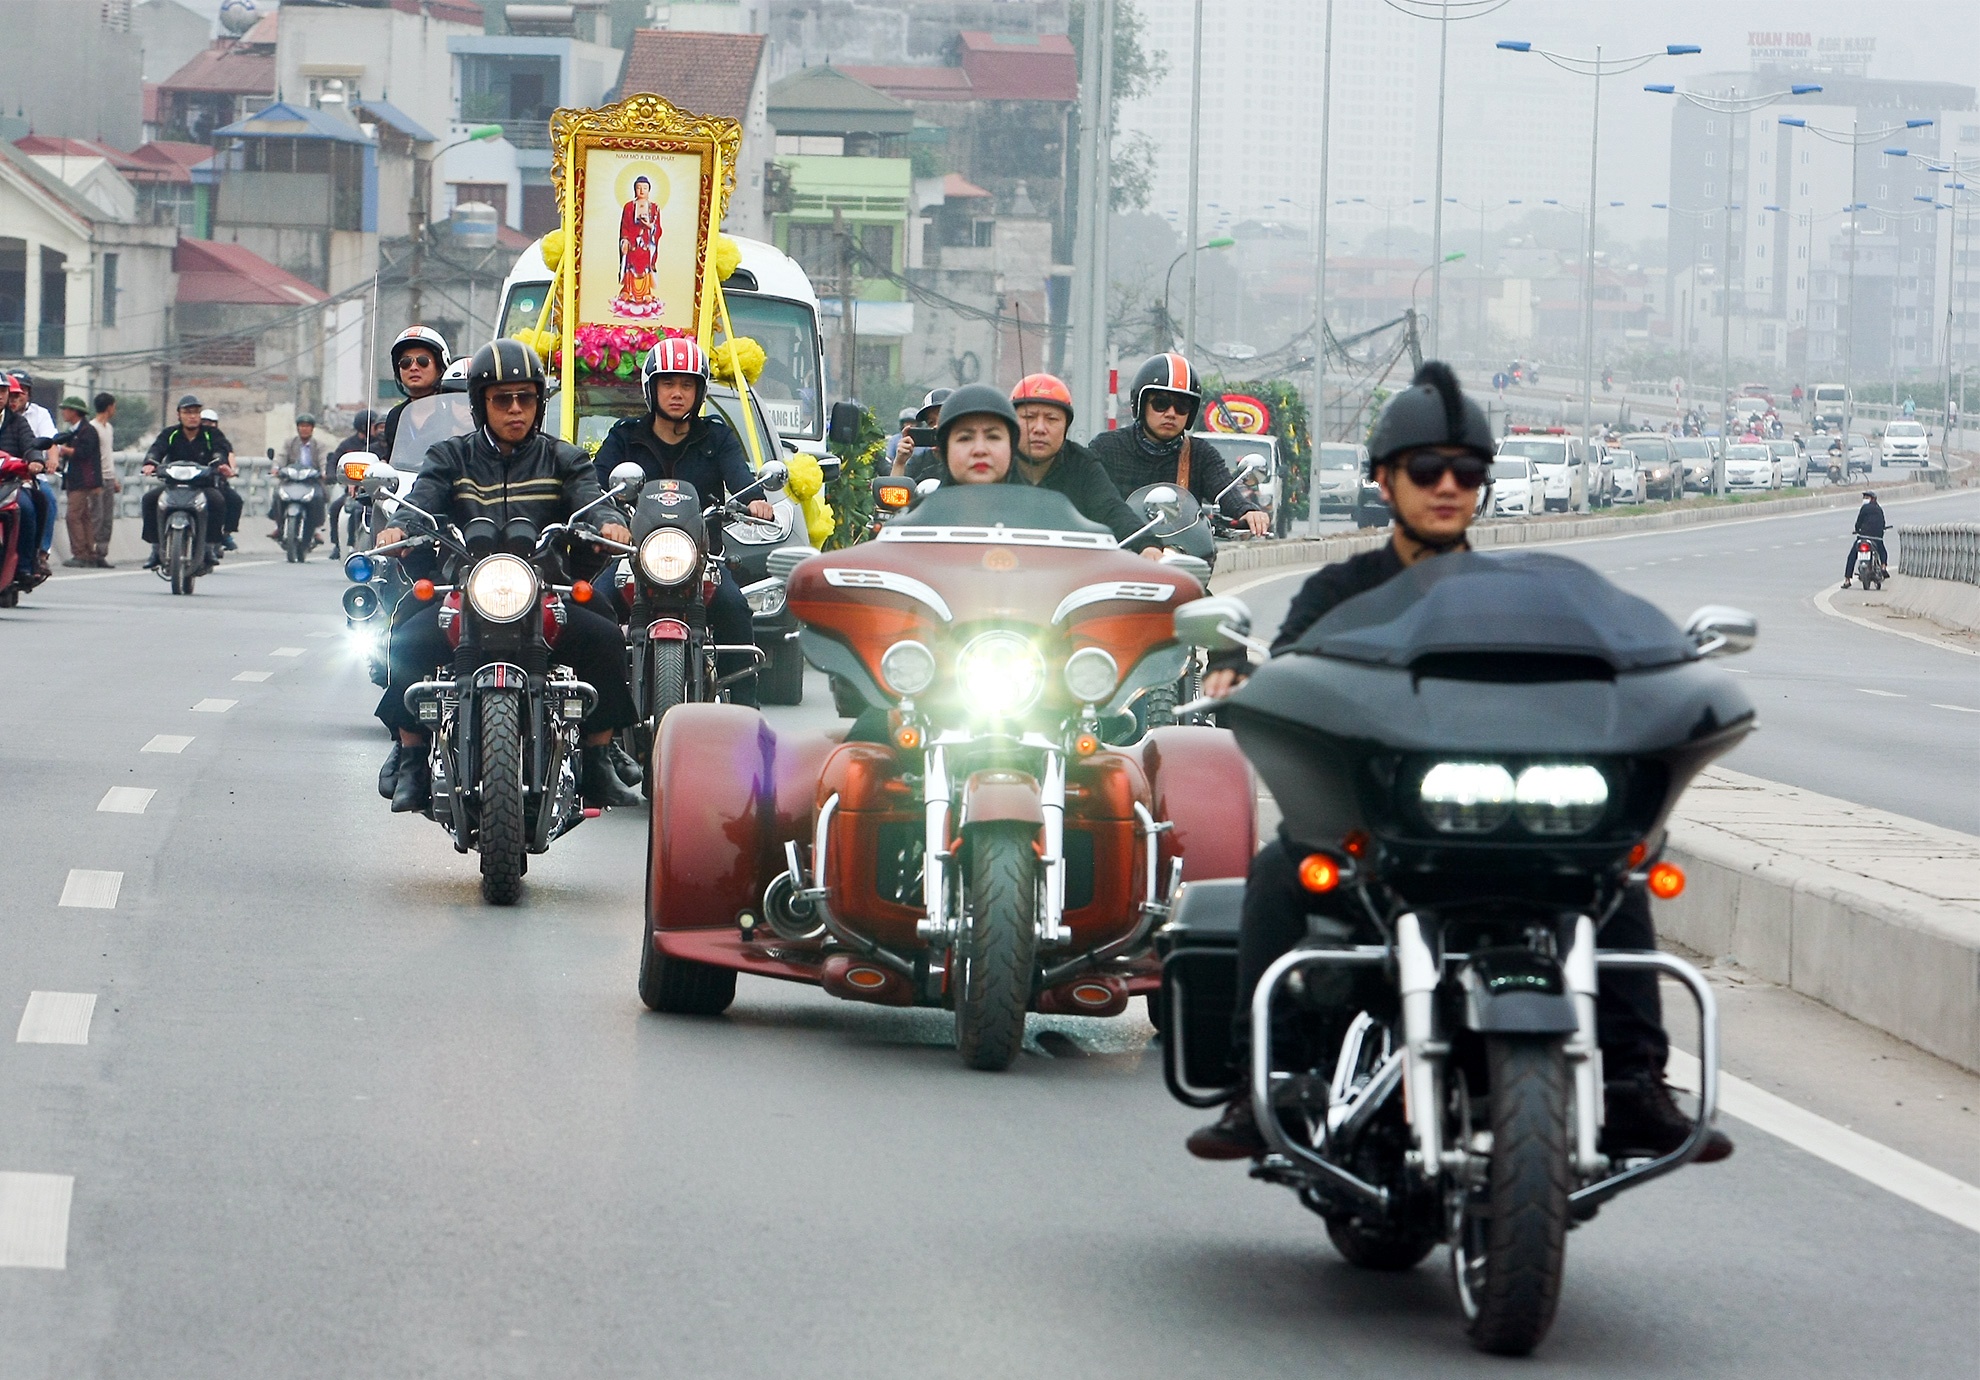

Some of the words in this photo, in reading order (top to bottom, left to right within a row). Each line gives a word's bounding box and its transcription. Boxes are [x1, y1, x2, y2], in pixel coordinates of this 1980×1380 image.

[1748, 31, 1782, 46] XUAN
[1786, 32, 1812, 47] HOA
[1751, 48, 1807, 57] APARTMENT
[769, 410, 788, 426] ANG
